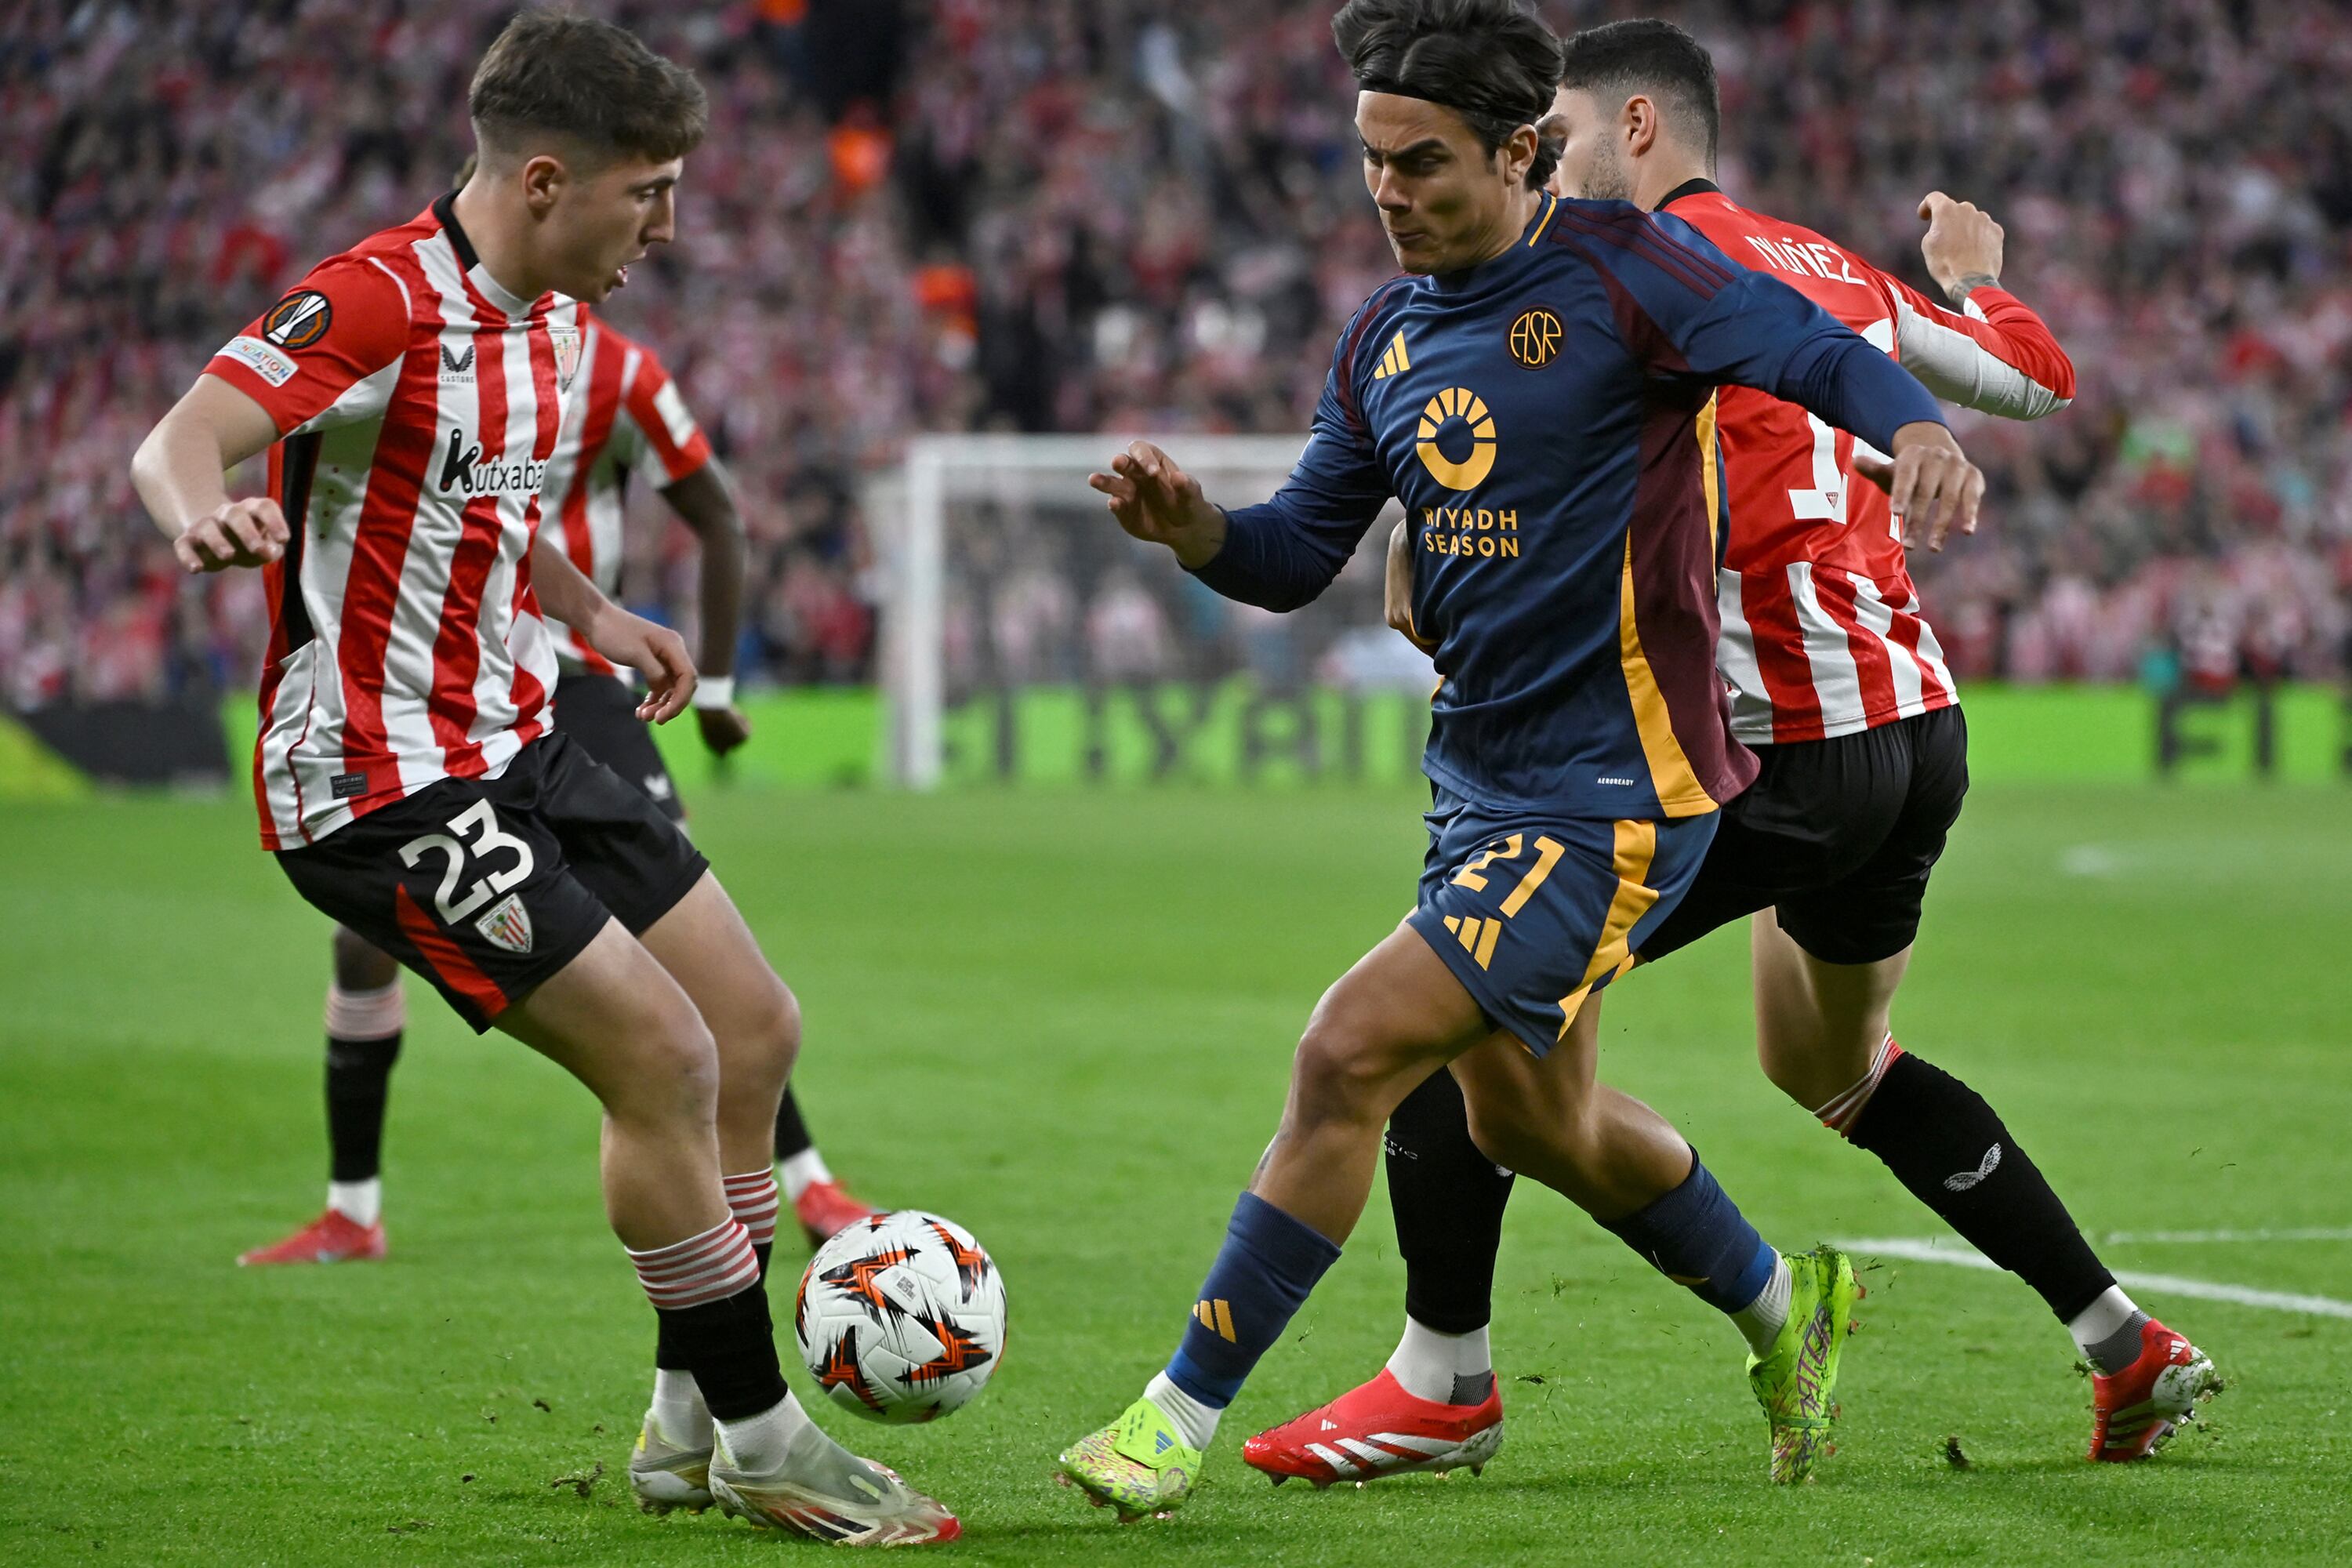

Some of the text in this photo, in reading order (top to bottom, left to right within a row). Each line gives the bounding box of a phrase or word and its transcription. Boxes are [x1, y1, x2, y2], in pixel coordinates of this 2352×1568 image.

[1744, 236, 1867, 285] NUÑEZ
[1510, 311, 1562, 365] ASR
[1422, 507, 1518, 531] RIYADH
[1425, 532, 1519, 558] SEASON
[1597, 777, 1635, 786] AEROREADY
[398, 797, 534, 926] 23
[1450, 833, 1565, 919] 21
